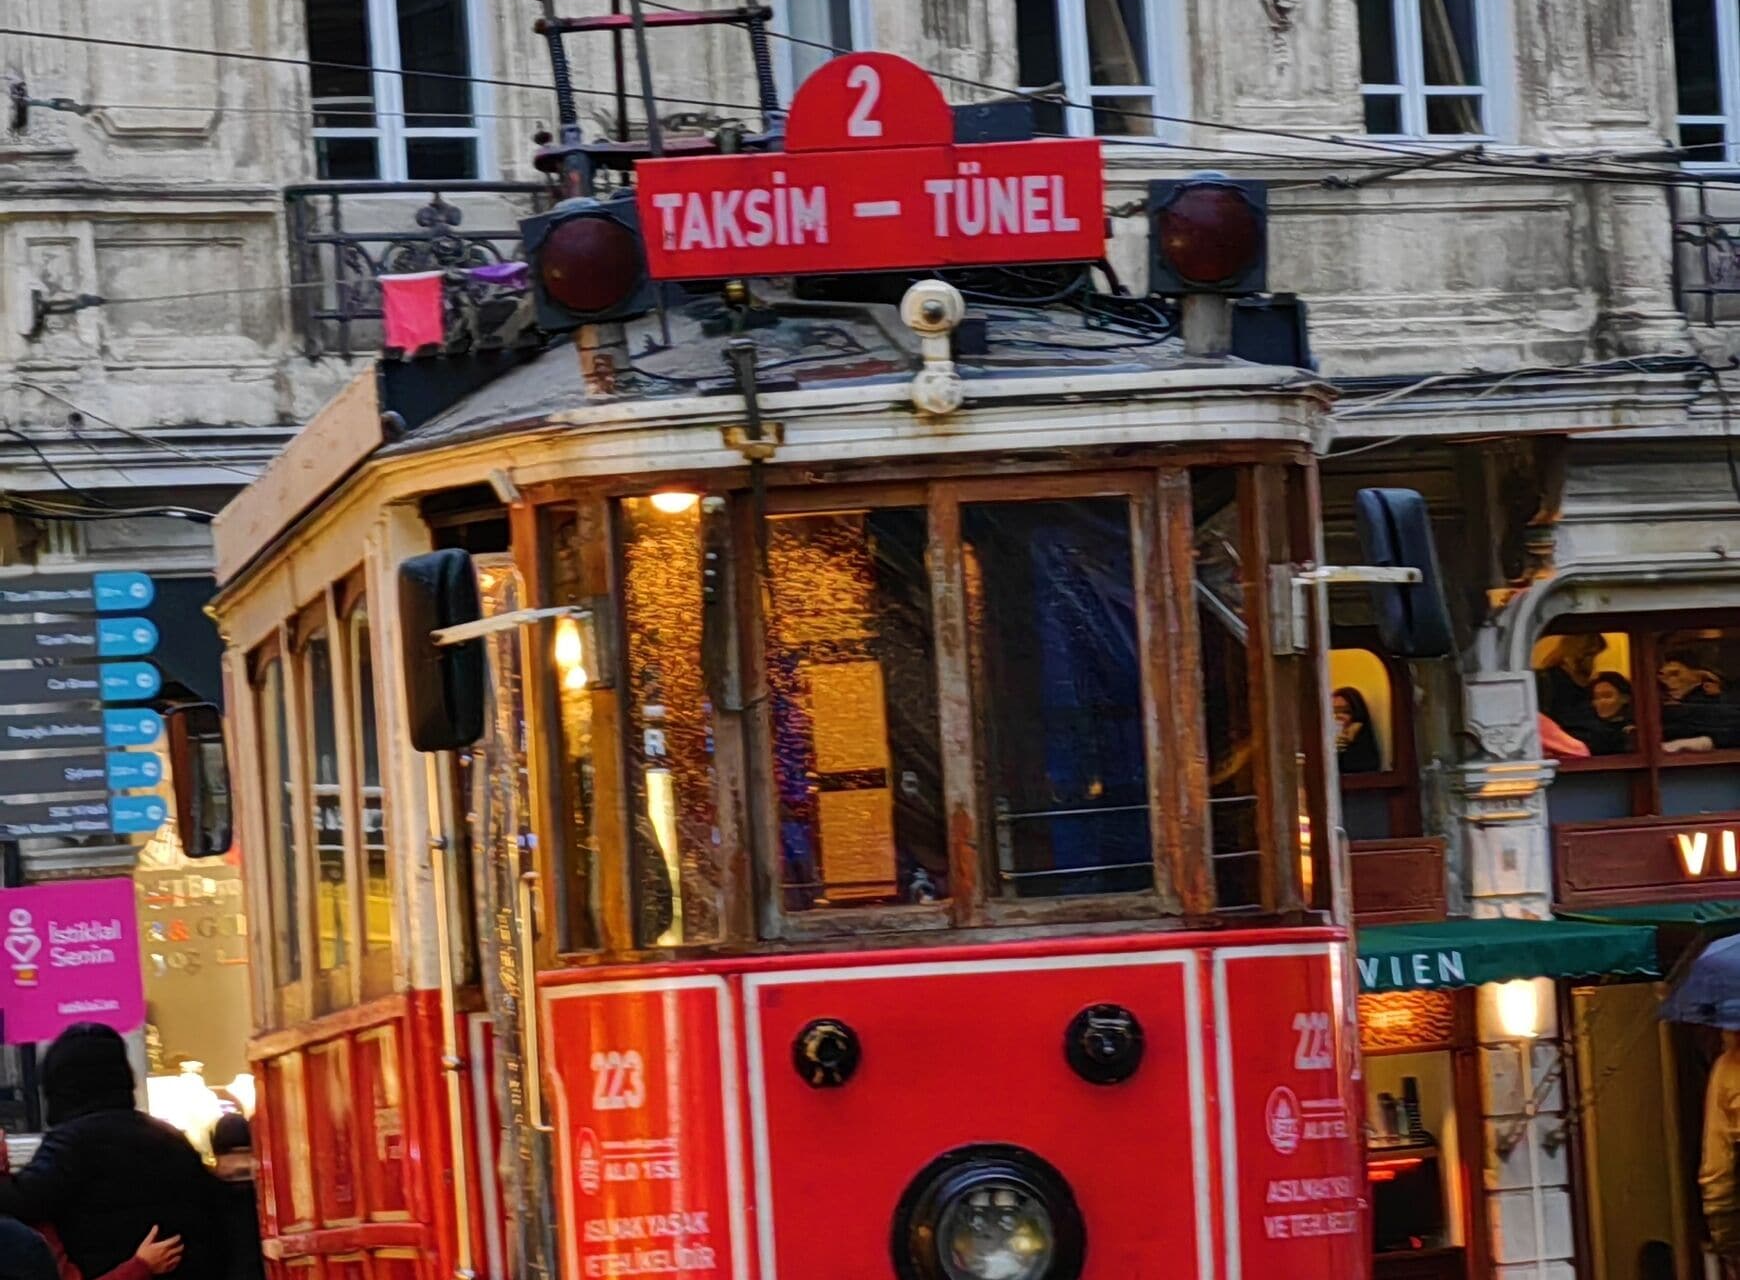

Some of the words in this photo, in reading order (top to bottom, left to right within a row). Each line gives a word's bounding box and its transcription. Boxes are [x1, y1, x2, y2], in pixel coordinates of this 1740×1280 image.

[846, 64, 882, 137] 2
[652, 171, 829, 251] TAKSİM
[924, 162, 1081, 237] TÜNEL
[1677, 830, 1737, 875] VI
[1355, 950, 1466, 988] VIEN
[590, 1049, 646, 1111] 223
